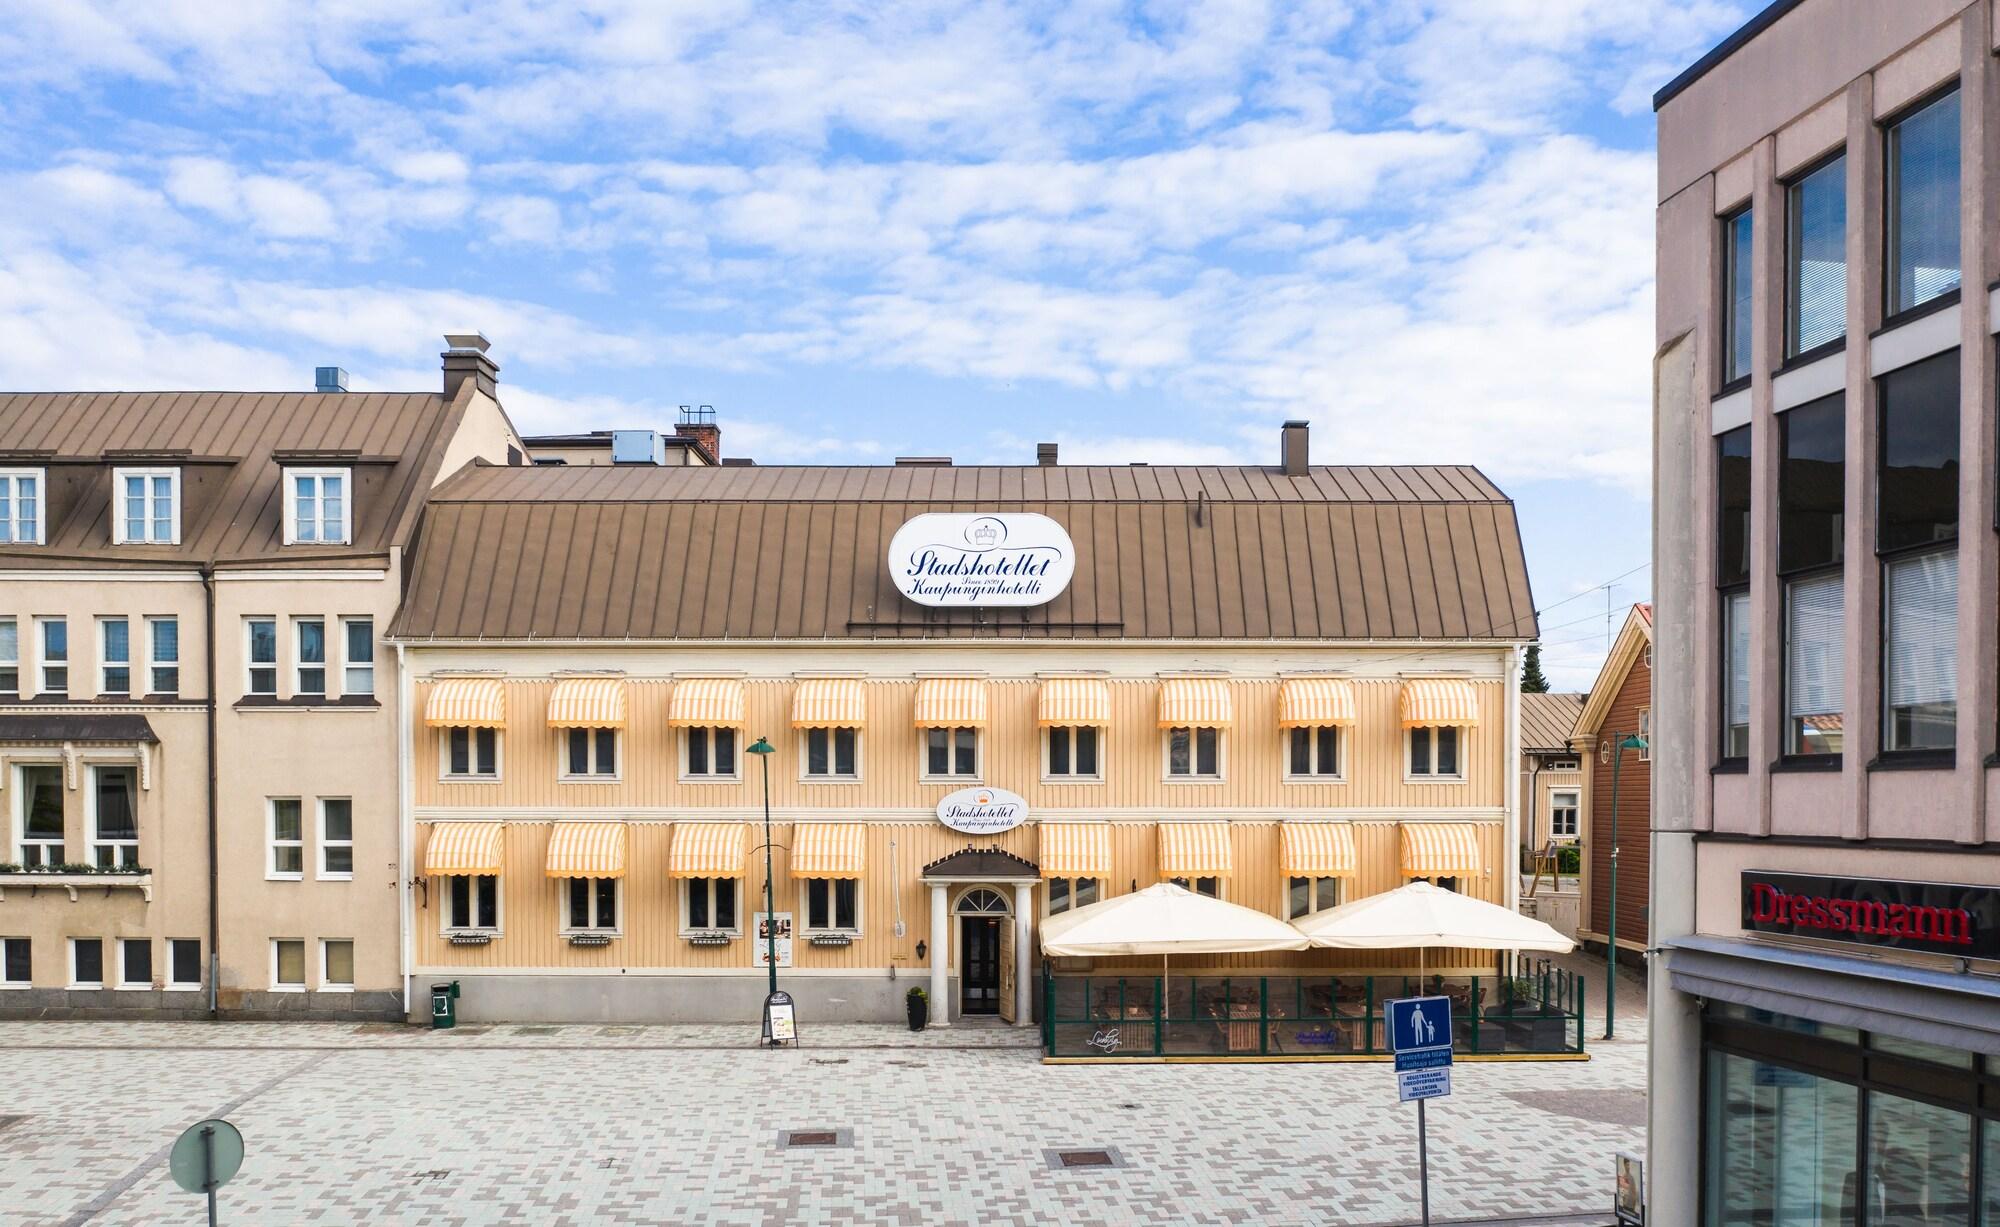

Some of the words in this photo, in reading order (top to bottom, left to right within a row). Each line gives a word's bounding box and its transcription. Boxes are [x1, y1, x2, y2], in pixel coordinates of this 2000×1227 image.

[907, 549, 1051, 577] Stadshotellet
[907, 578, 1042, 601] Kaupunginhotelli
[946, 805, 1014, 818] Stadshotellet
[950, 818, 1014, 829] Kaupunginhotelli
[1752, 882, 1974, 945] Dressmann
